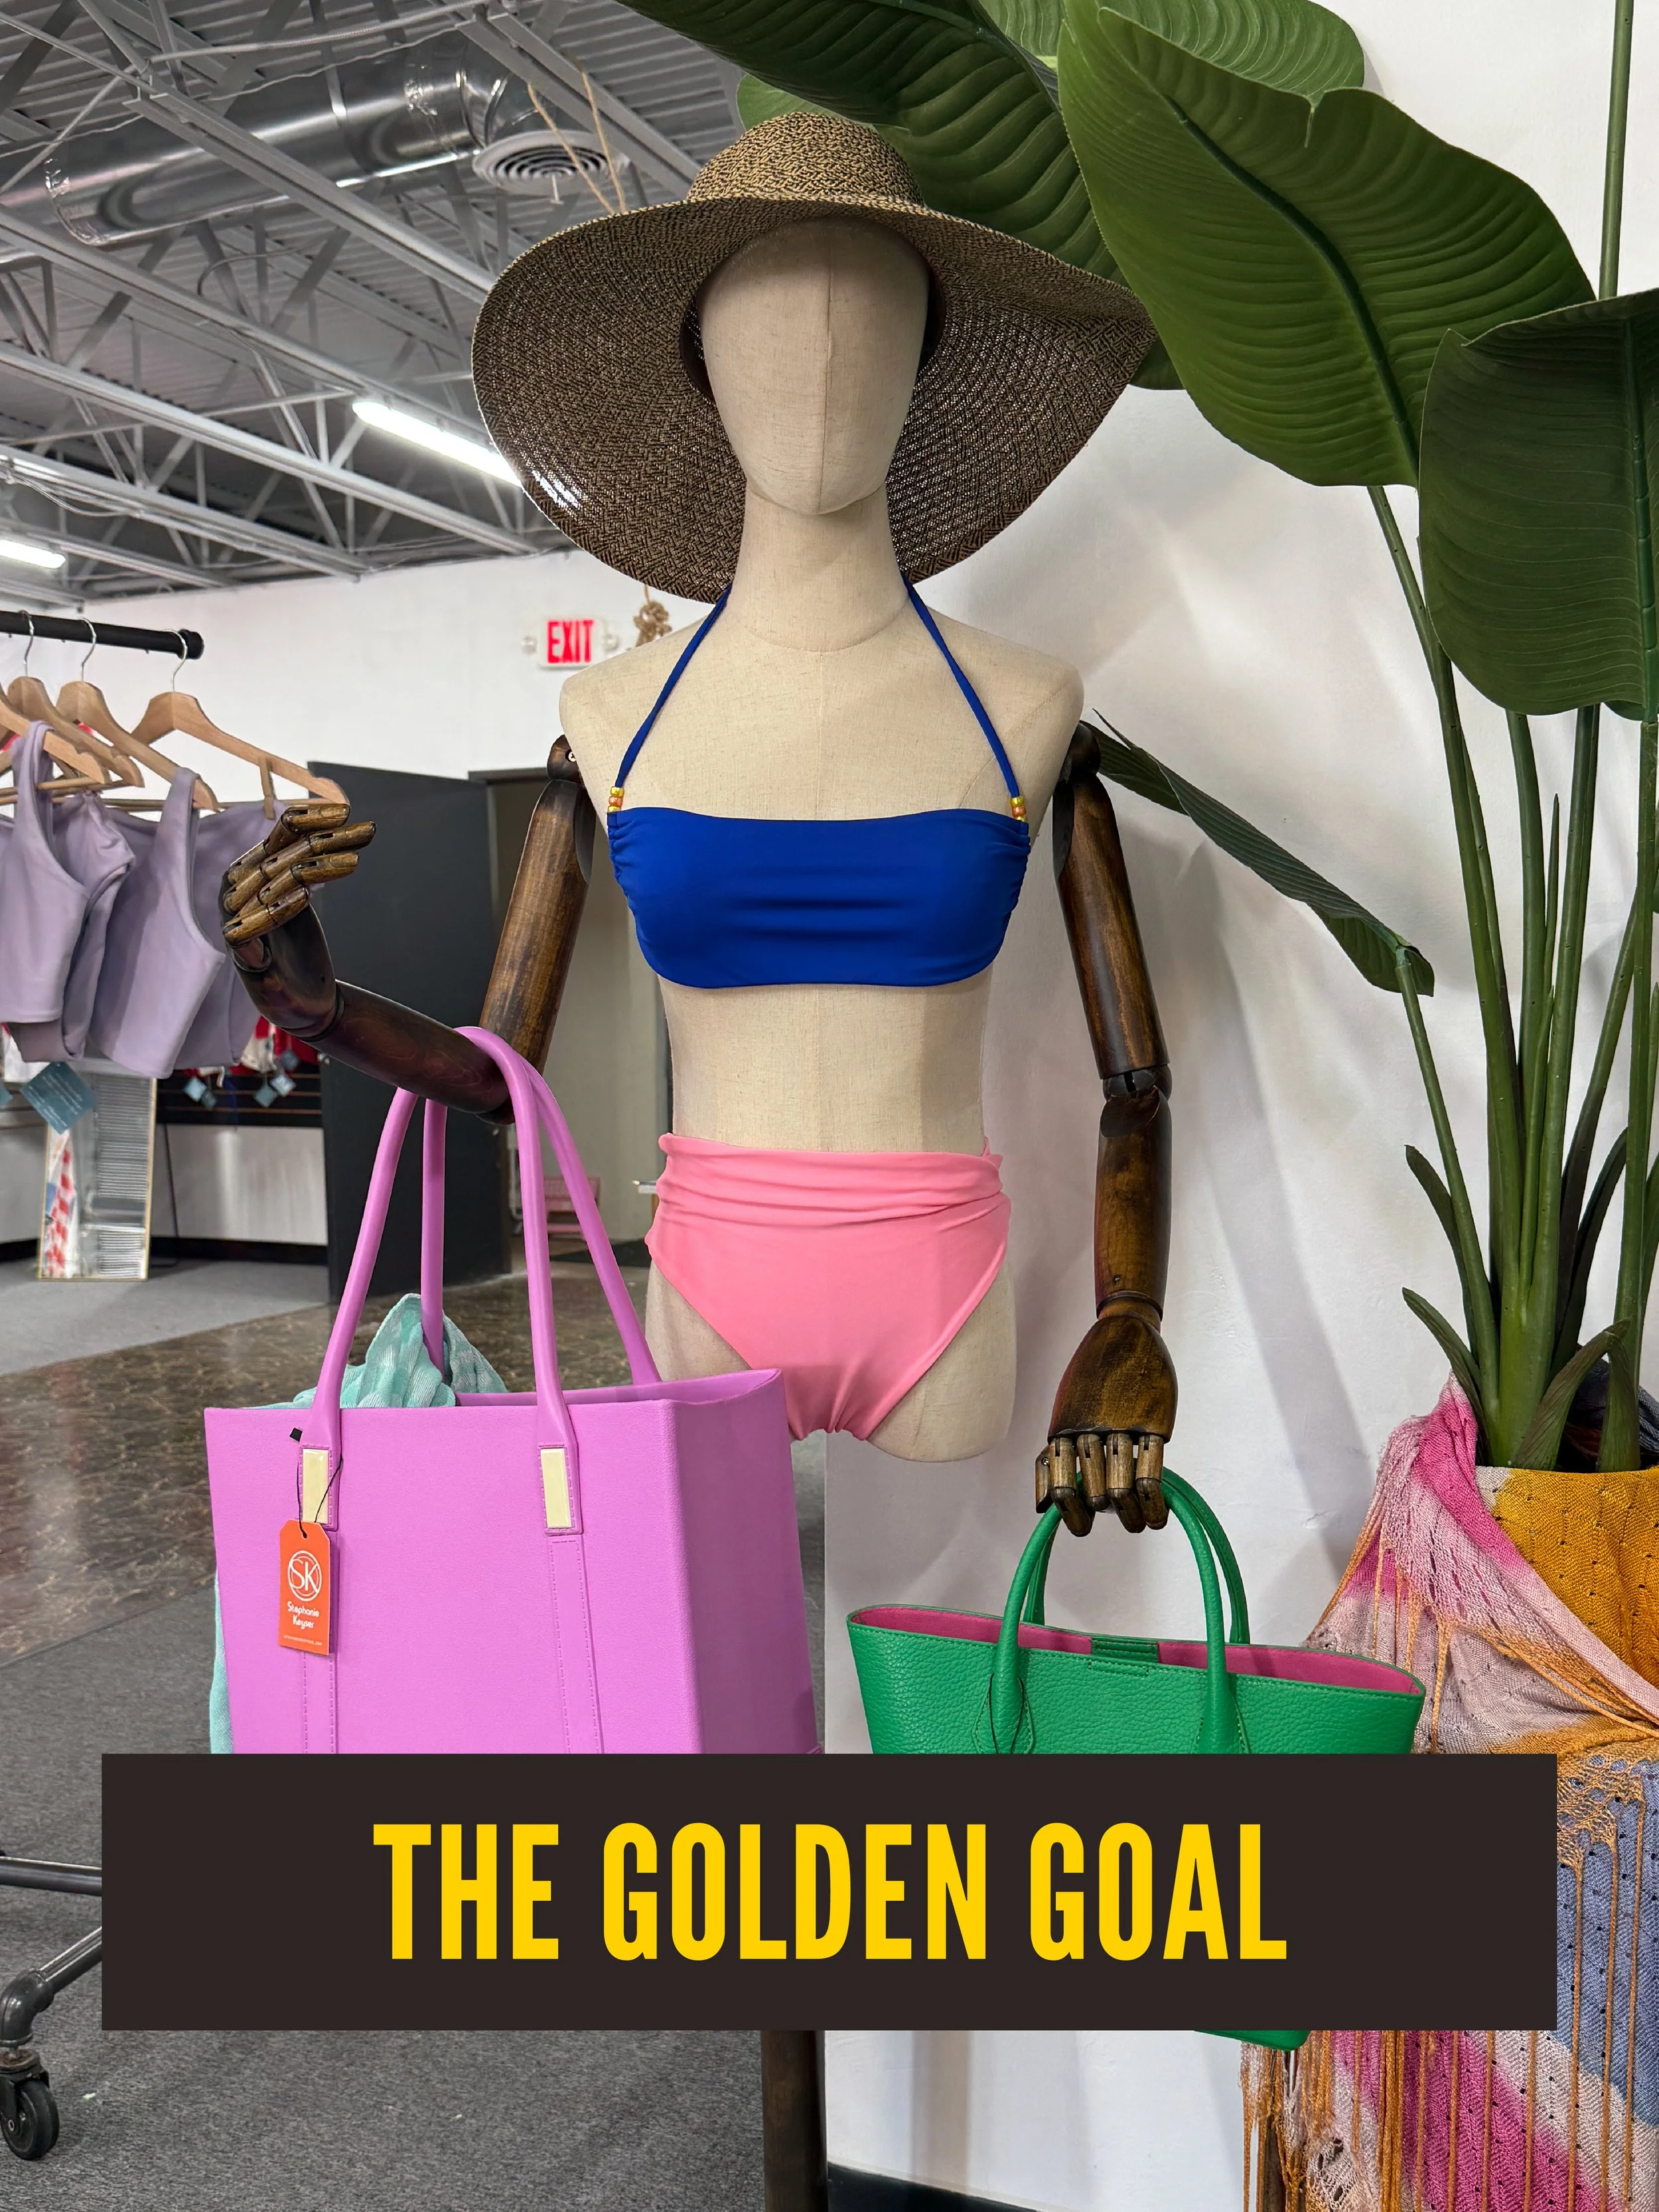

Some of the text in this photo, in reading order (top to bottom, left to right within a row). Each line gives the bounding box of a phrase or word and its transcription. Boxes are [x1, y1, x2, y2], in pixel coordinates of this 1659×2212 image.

[547, 619, 594, 664] EXIT
[290, 1558, 319, 1593] SK
[287, 1600, 320, 1617] Stephanie
[293, 1614, 315, 1630] Keyser
